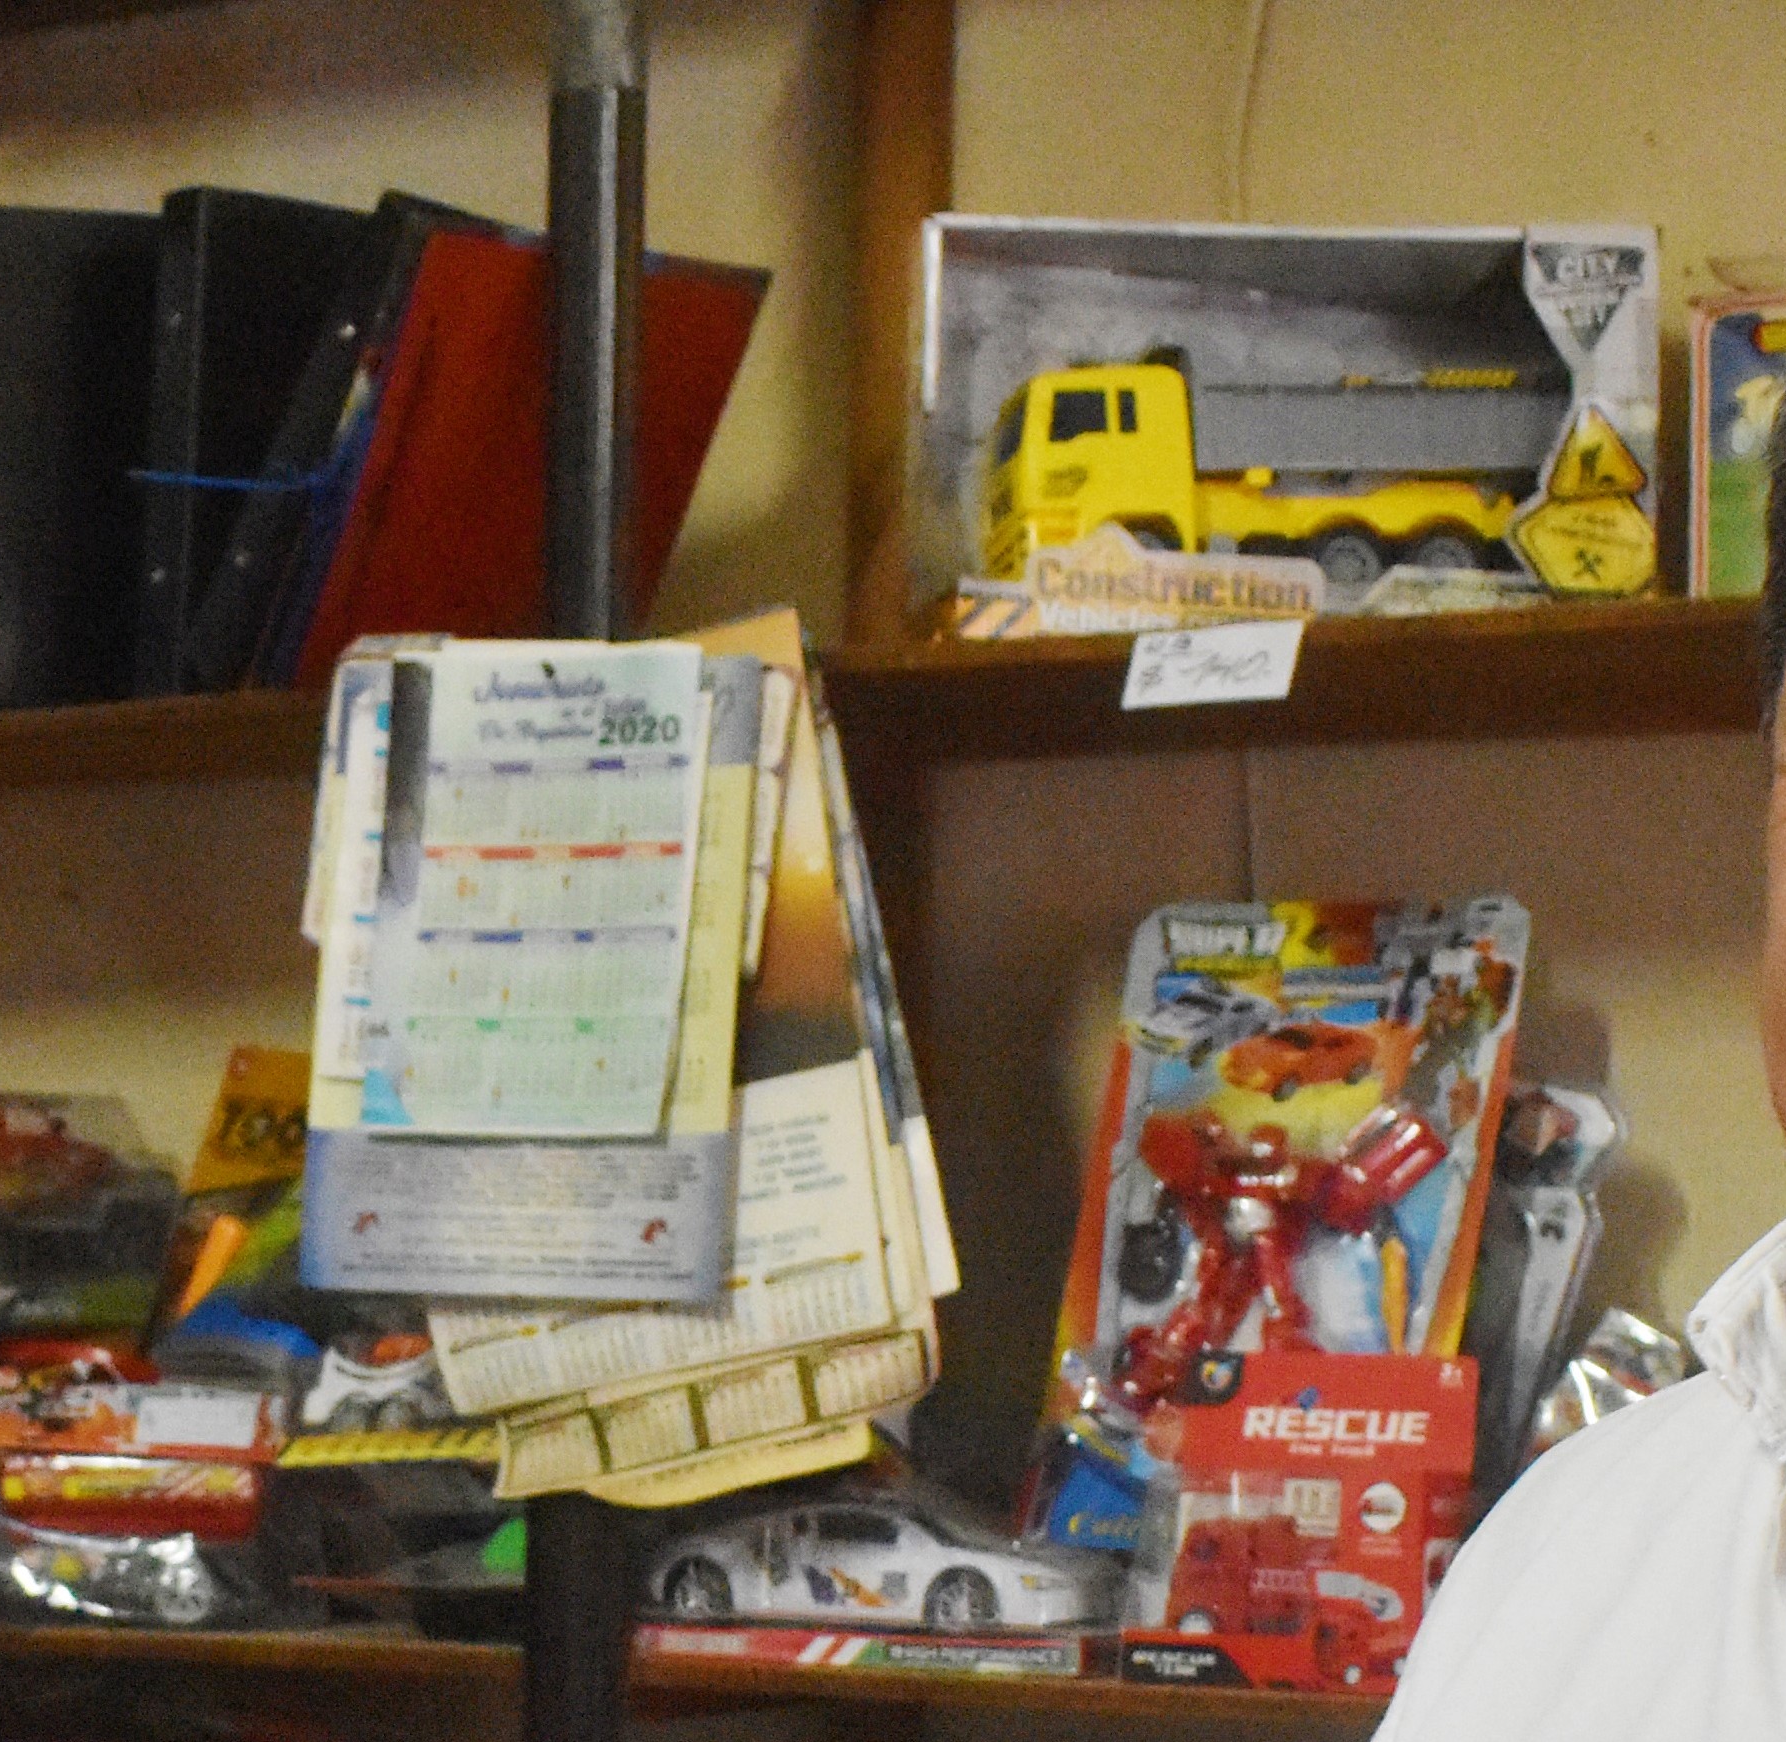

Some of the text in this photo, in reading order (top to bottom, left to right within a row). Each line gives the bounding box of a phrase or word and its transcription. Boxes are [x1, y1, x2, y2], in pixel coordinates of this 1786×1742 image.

[1037, 556, 1313, 612] Construction
[597, 713, 682, 746] 2020
[1241, 1405, 1431, 1444] RESCUE
